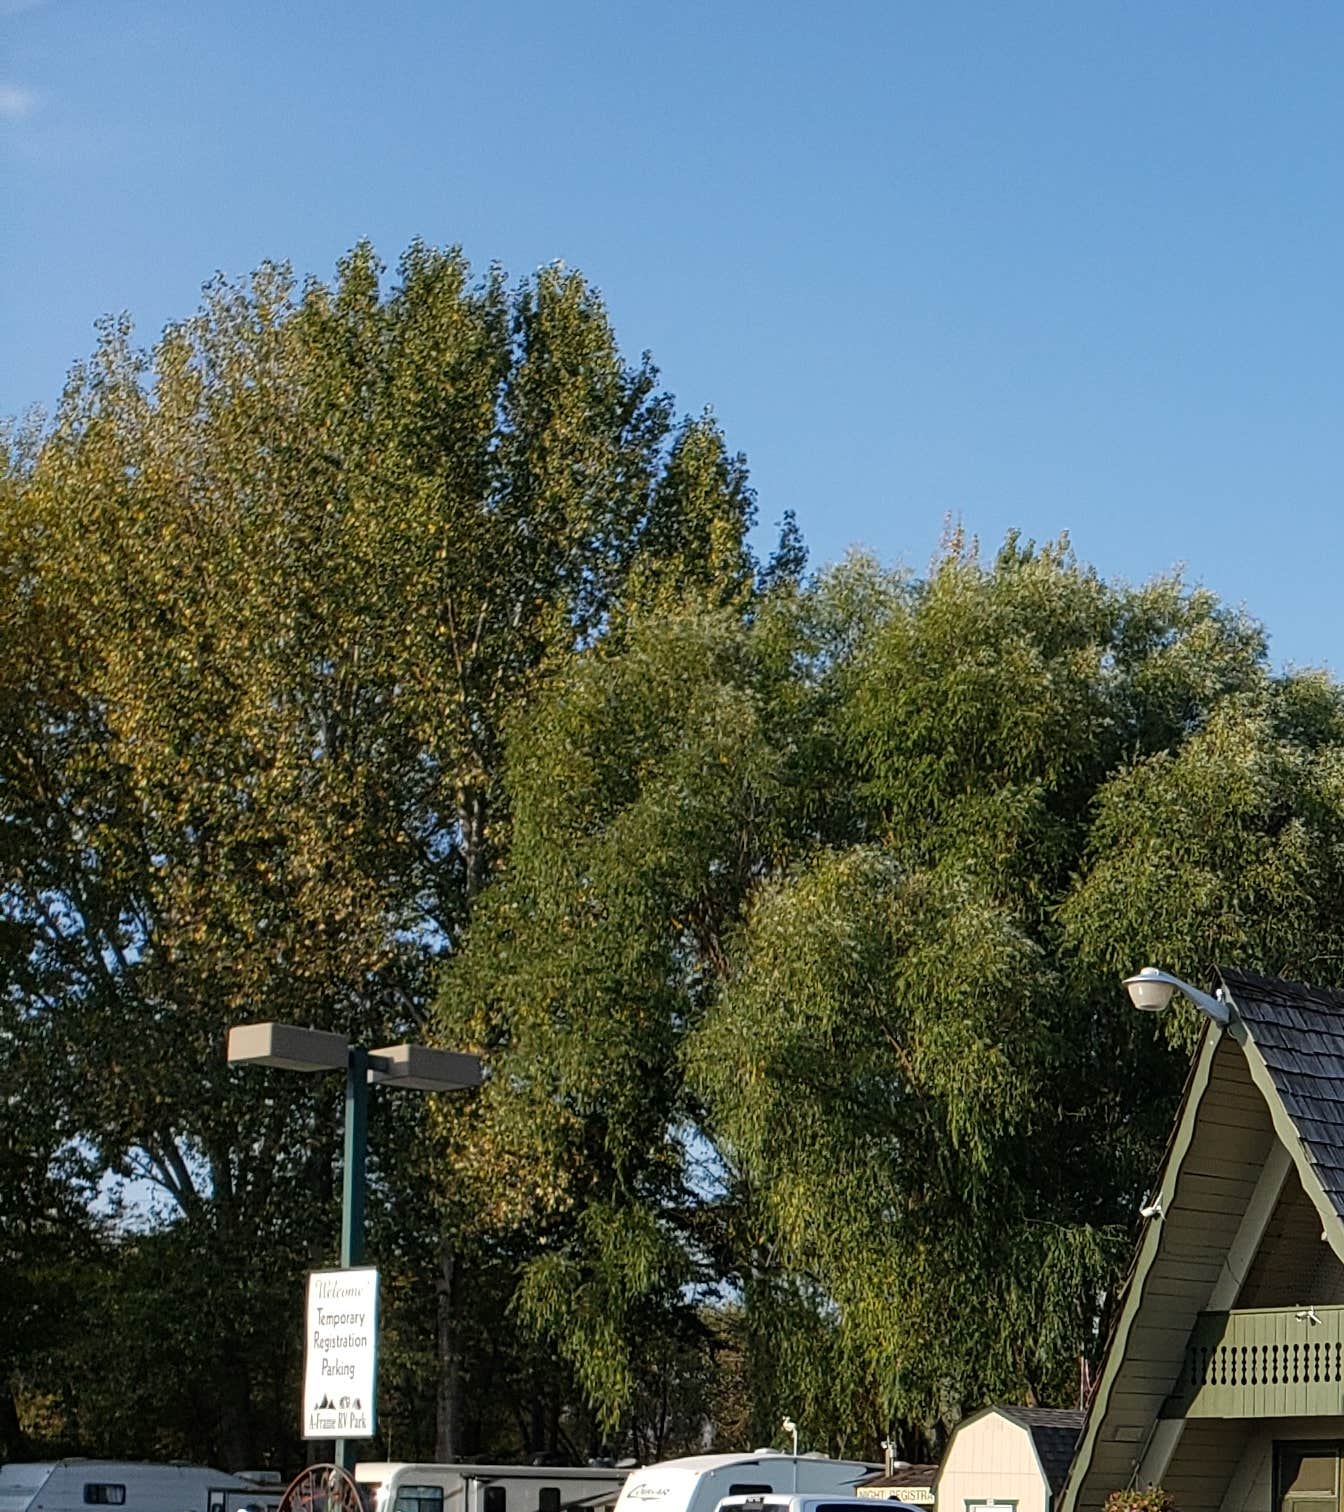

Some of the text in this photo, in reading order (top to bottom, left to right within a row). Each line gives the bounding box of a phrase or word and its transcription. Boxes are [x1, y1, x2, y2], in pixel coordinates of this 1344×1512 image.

[315, 1280, 364, 1299] Welcome
[316, 1307, 366, 1328] Temporary
[313, 1331, 367, 1352] Registration
[321, 1357, 356, 1380] Parking
[350, 1411, 367, 1429] Park
